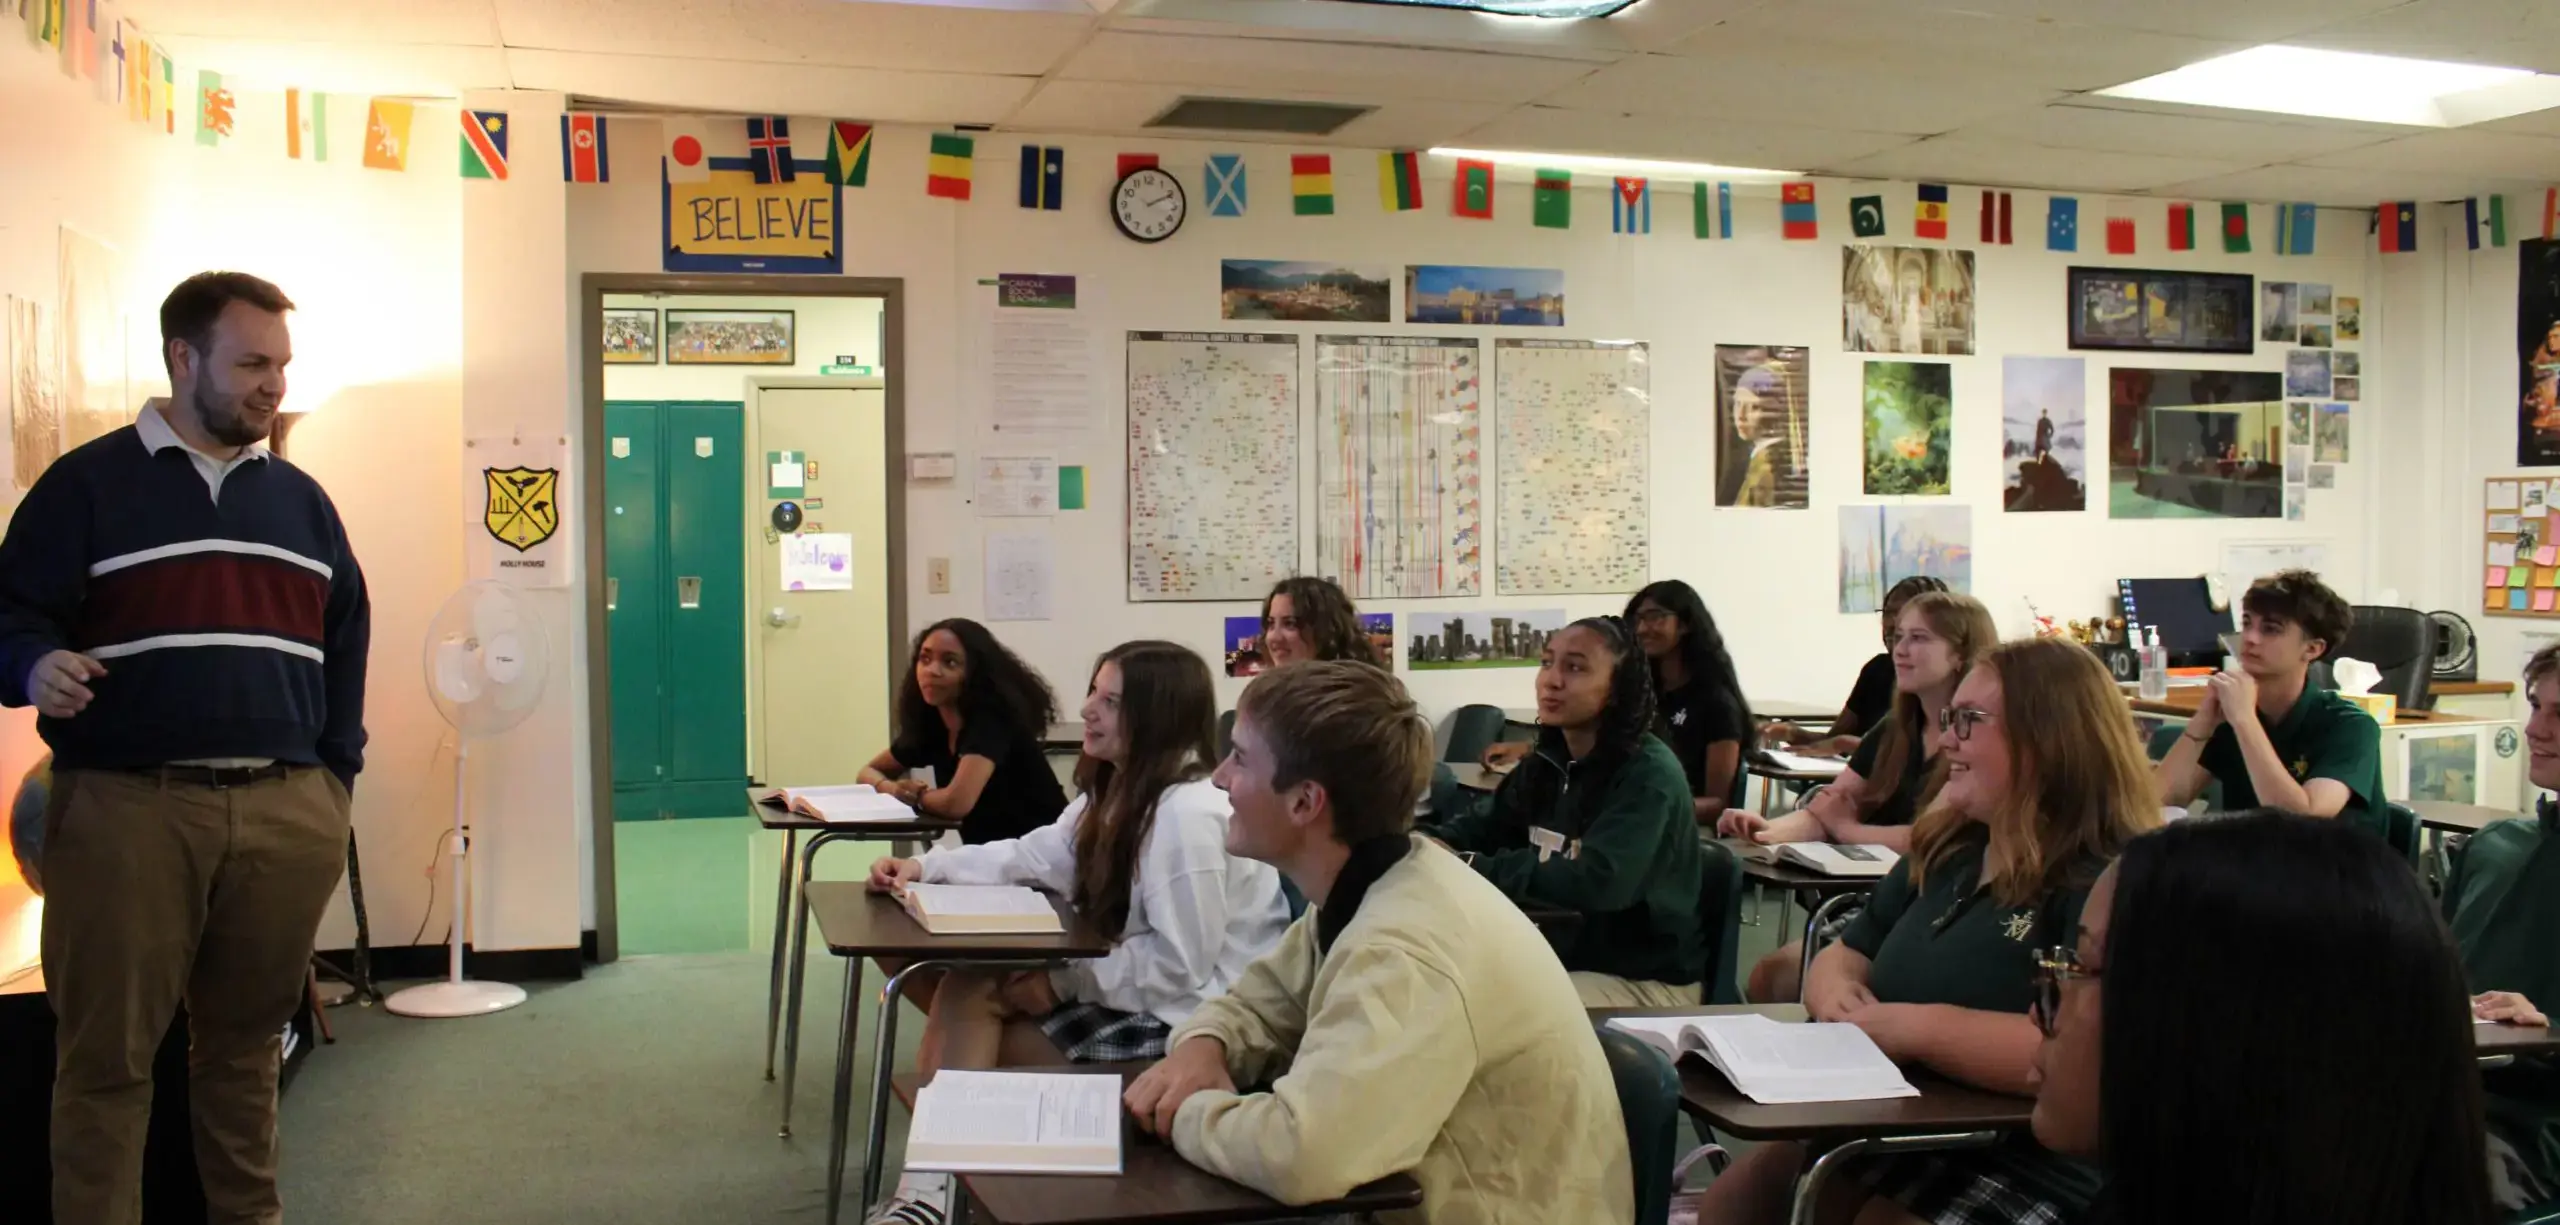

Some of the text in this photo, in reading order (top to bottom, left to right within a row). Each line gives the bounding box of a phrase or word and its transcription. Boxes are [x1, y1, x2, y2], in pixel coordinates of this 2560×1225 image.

[1133, 179, 1140, 189] 11
[1143, 173, 1155, 186] 12
[1124, 188, 1135, 198] 10
[1166, 189, 1174, 199] 2
[1120, 200, 1127, 210] 9
[1171, 202, 1178, 211] 3
[688, 197, 830, 241] BELIEVE
[1124, 212, 1131, 222] 8
[1165, 214, 1174, 222] 4
[1132, 221, 1140, 231] 7
[1145, 225, 1153, 235] 6
[1158, 222, 1165, 231] 5
[2110, 651, 2130, 677] 10
